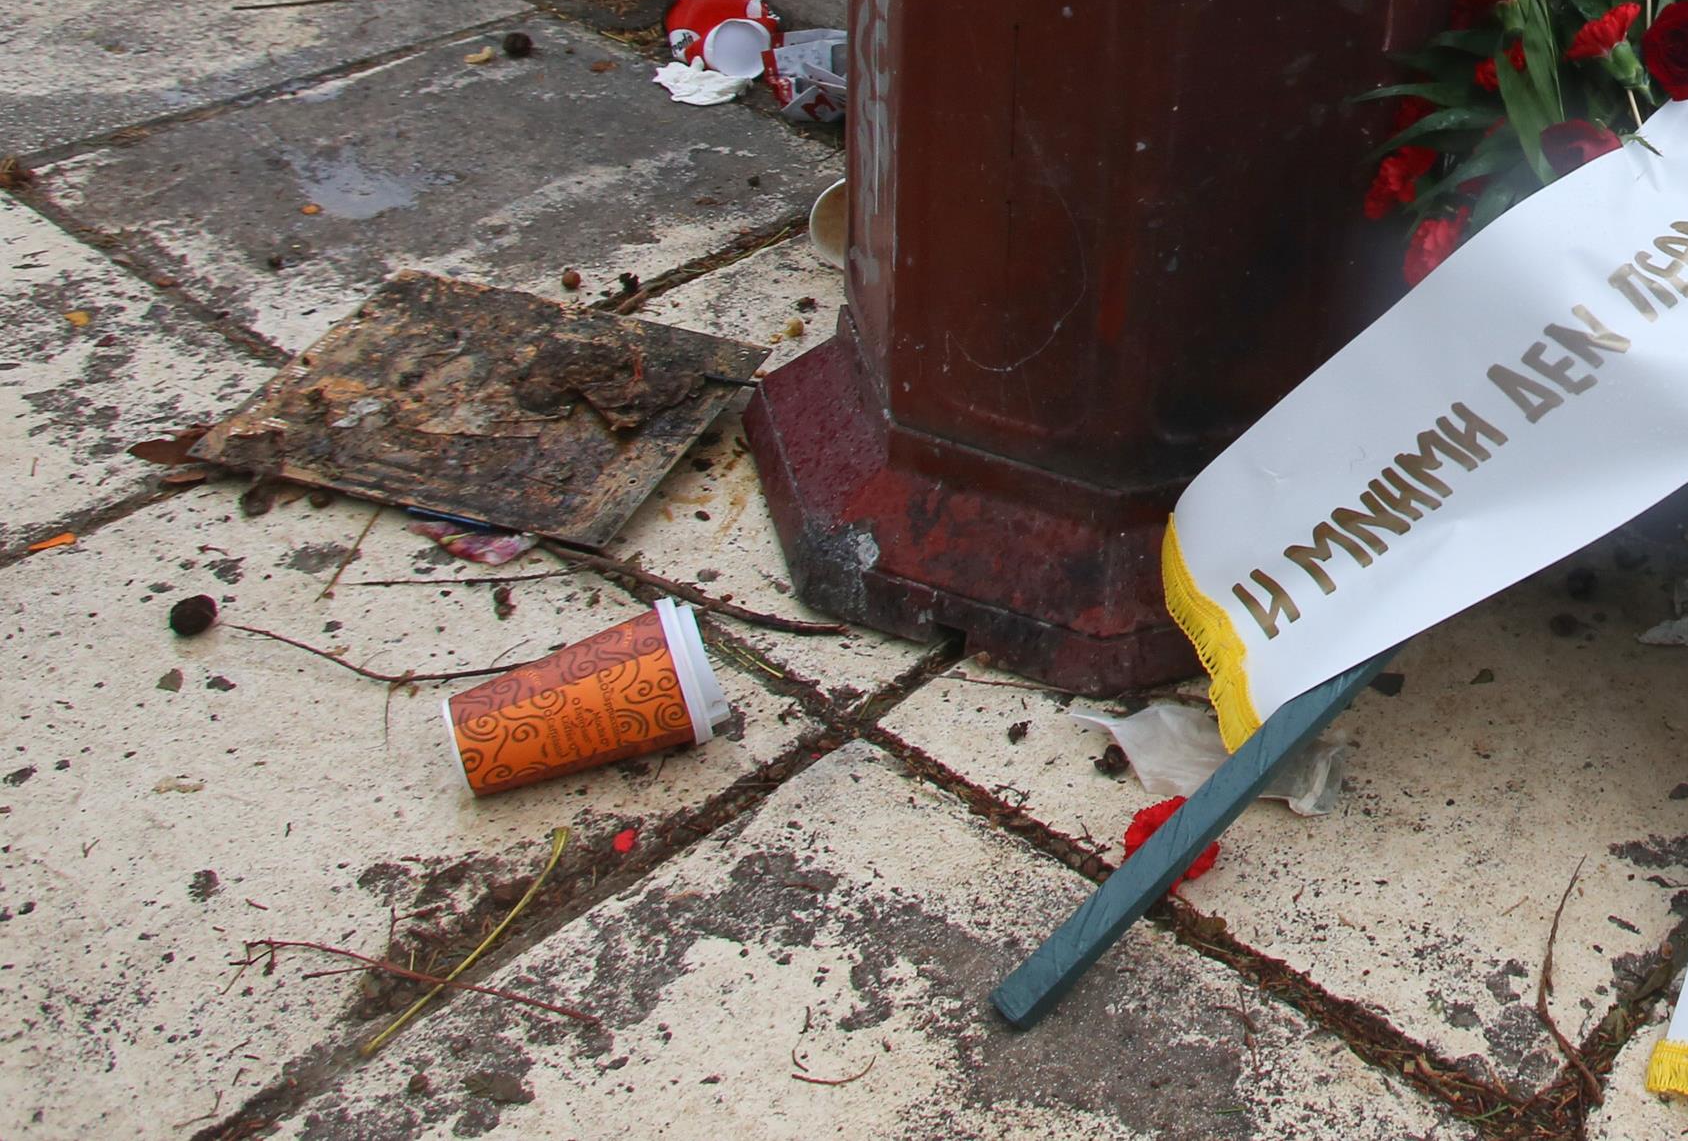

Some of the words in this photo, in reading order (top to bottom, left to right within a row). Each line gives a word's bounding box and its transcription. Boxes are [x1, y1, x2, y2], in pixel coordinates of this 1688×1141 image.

[1232, 568, 1301, 640] Η
[1283, 401, 1509, 596] ΜΝΗΜΗ
[1486, 303, 1632, 424] ΔΕΝ
